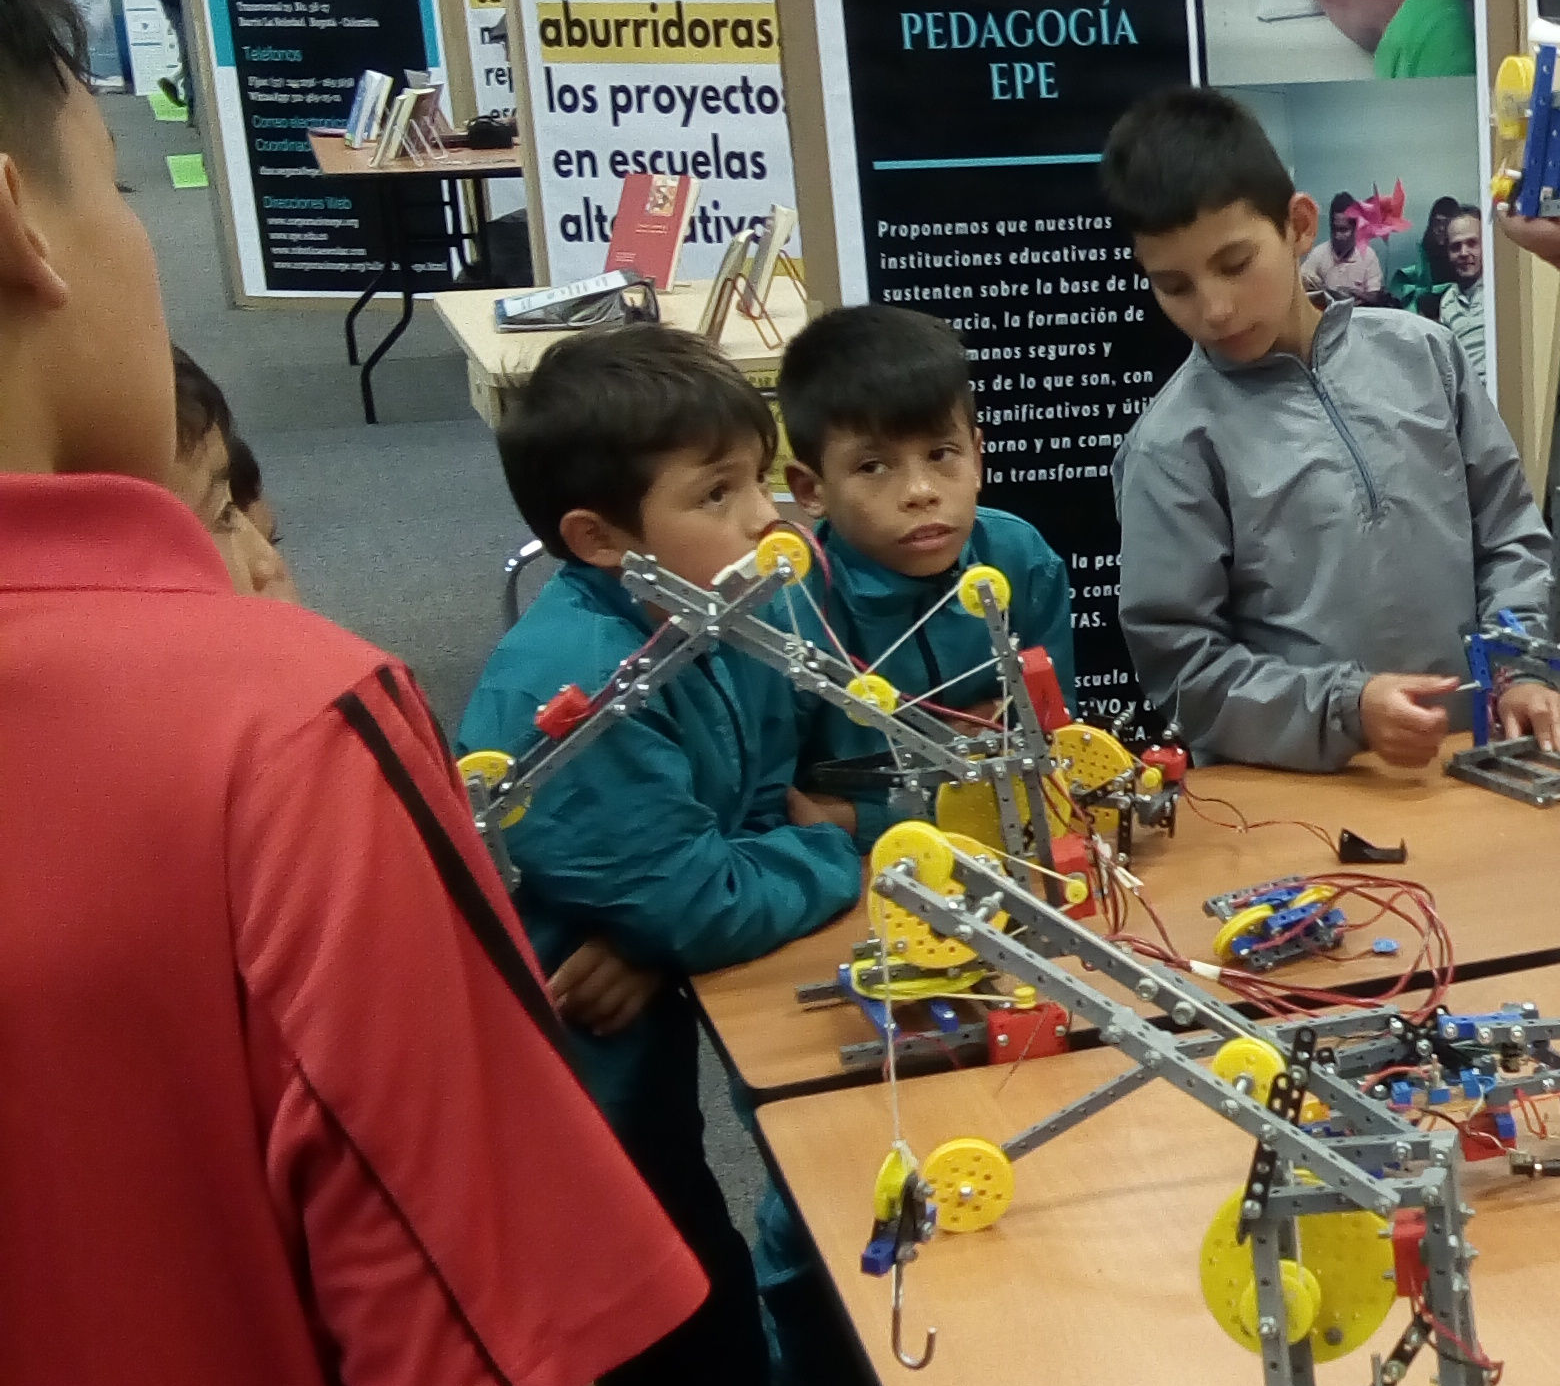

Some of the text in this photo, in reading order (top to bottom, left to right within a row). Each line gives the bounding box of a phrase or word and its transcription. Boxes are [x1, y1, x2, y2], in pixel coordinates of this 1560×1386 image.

[544, 66, 599, 114] los
[990, 61, 1060, 100] EPE
[553, 132, 768, 180] en escuelas
[878, 215, 1113, 240] Proponemos que nuestras
[880, 245, 1132, 270] instituciones educativas se
[883, 274, 1150, 302] sustenten sobre la base de la
[1004, 311, 1020, 328] la
[1027, 307, 1117, 330] formación
[1124, 305, 1145, 322] de
[1028, 342, 1096, 361] seguros
[1103, 342, 1112, 358] y
[992, 376, 1013, 391] de
[1019, 373, 1036, 390] lo
[1043, 372, 1074, 391] que
[1081, 373, 1118, 388] son,
[1123, 370, 1153, 384] con
[977, 399, 1100, 425] significativos
[1107, 402, 1116, 418] y
[1034, 438, 1043, 454] y
[1051, 436, 1072, 449] un
[987, 468, 1002, 484] la
[1071, 553, 1088, 570] la
